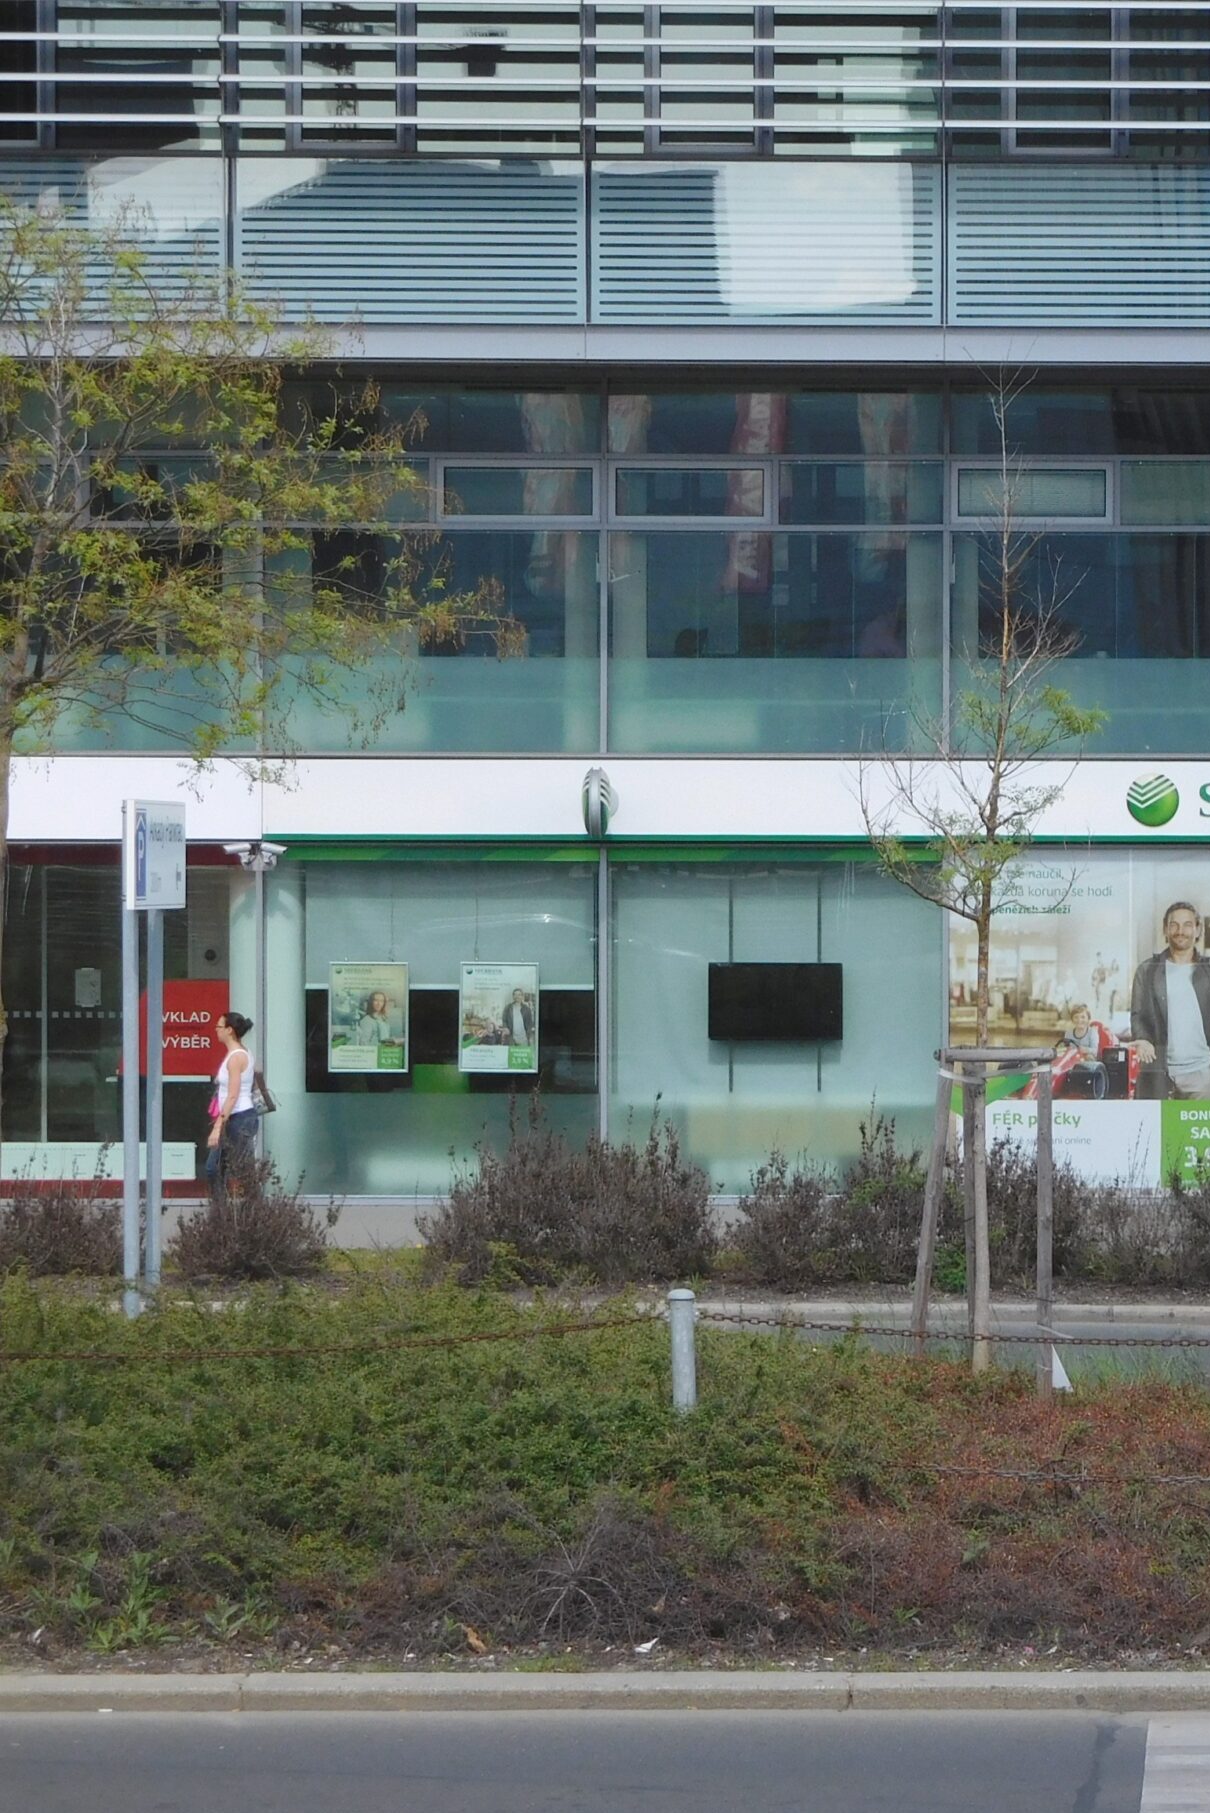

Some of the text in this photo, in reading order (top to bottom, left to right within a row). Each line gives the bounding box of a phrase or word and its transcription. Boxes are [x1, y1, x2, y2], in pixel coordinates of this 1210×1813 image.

[1028, 886, 1070, 897] koruna
[1071, 888, 1084, 897] se
[162, 1011, 211, 1023] VKLAD
[162, 1034, 211, 1048] VÝBĚR
[992, 1110, 1024, 1125] FÉR
